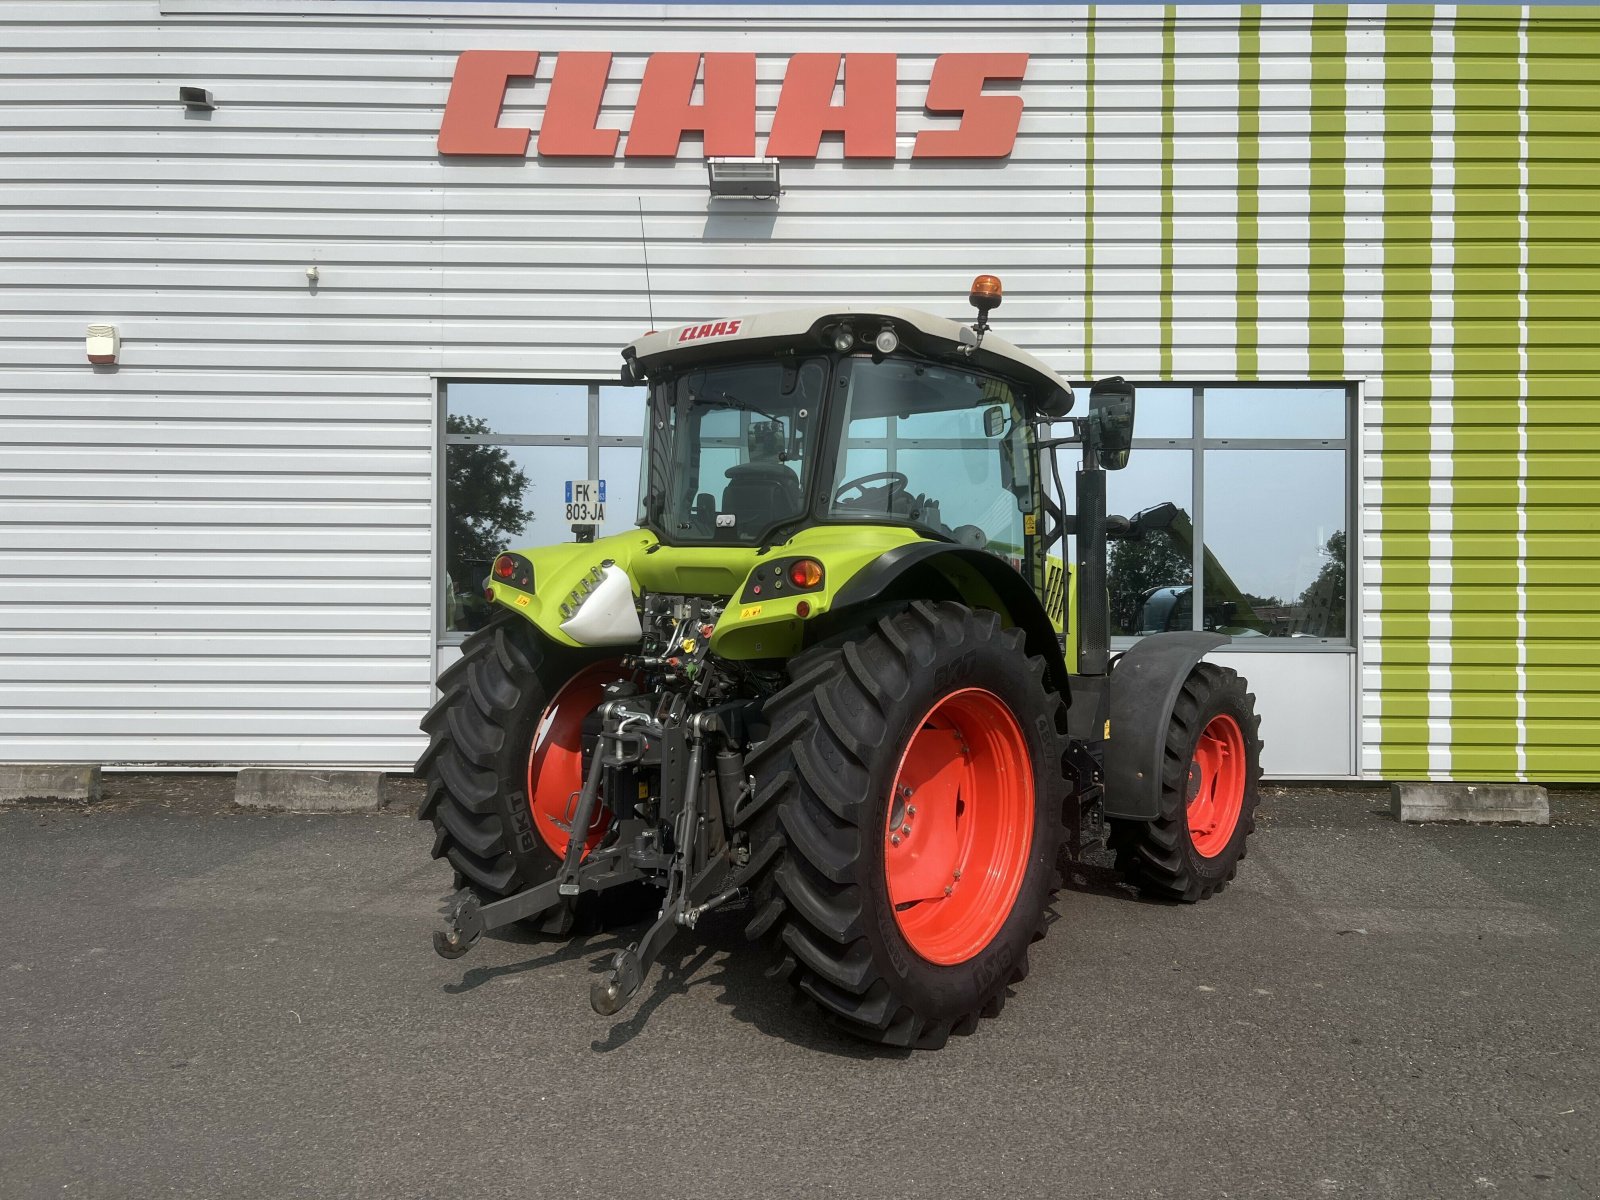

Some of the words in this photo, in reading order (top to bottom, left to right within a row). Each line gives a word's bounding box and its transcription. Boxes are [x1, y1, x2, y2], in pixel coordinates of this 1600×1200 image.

[437, 50, 1029, 157] CLAAS
[679, 320, 741, 342] CLAAS
[566, 503, 605, 521] 803-JA
[507, 792, 536, 852] BKT
